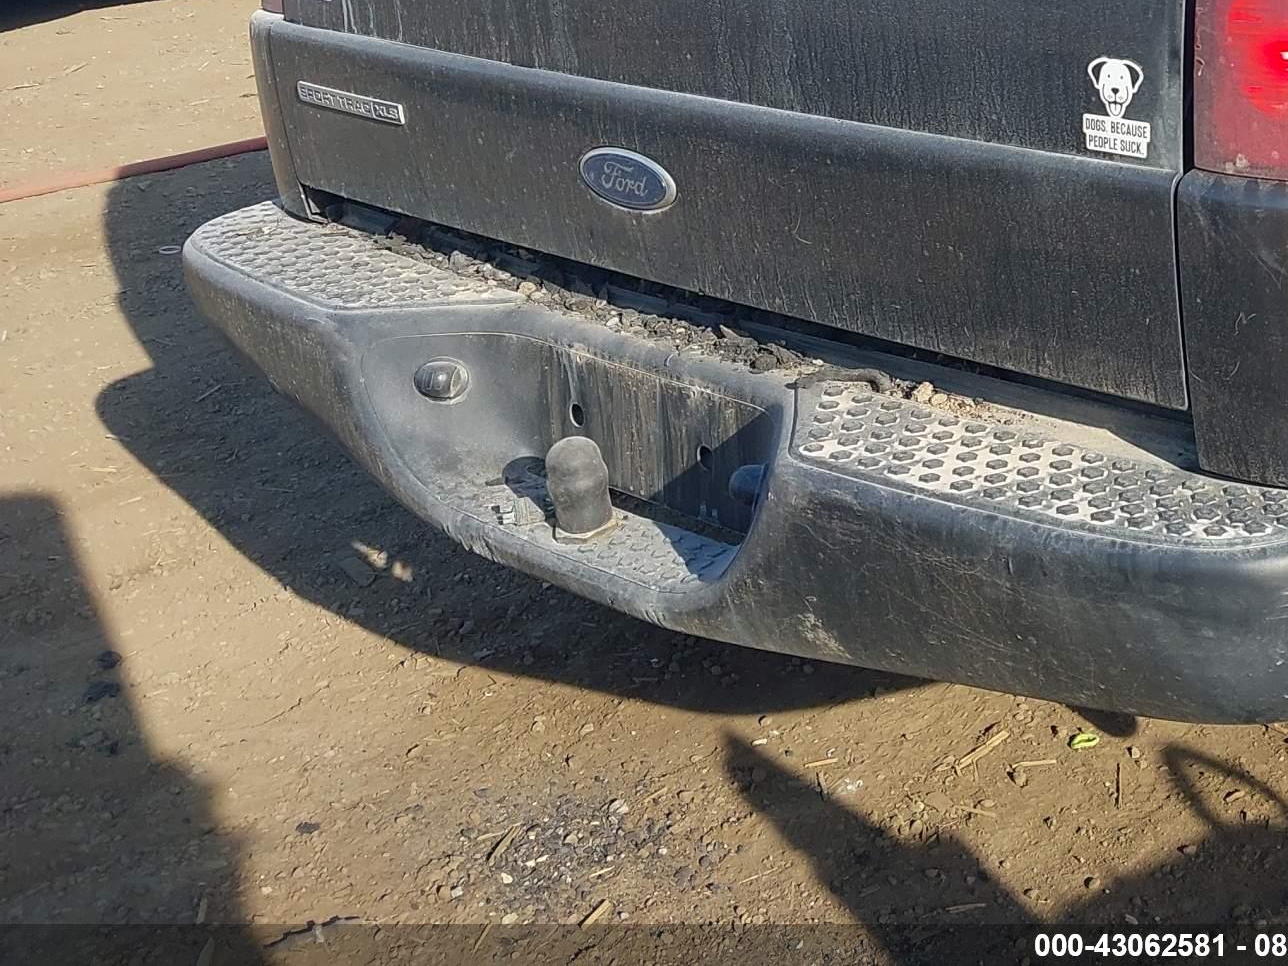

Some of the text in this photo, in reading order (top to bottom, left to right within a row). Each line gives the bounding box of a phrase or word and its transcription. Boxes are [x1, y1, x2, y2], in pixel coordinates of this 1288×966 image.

[300, 88, 335, 107] SPORT
[337, 96, 371, 115] TRAC
[1110, 121, 1148, 139] BECAUSE
[1088, 134, 1118, 151] PEOPLE
[601, 161, 649, 197] Ford
